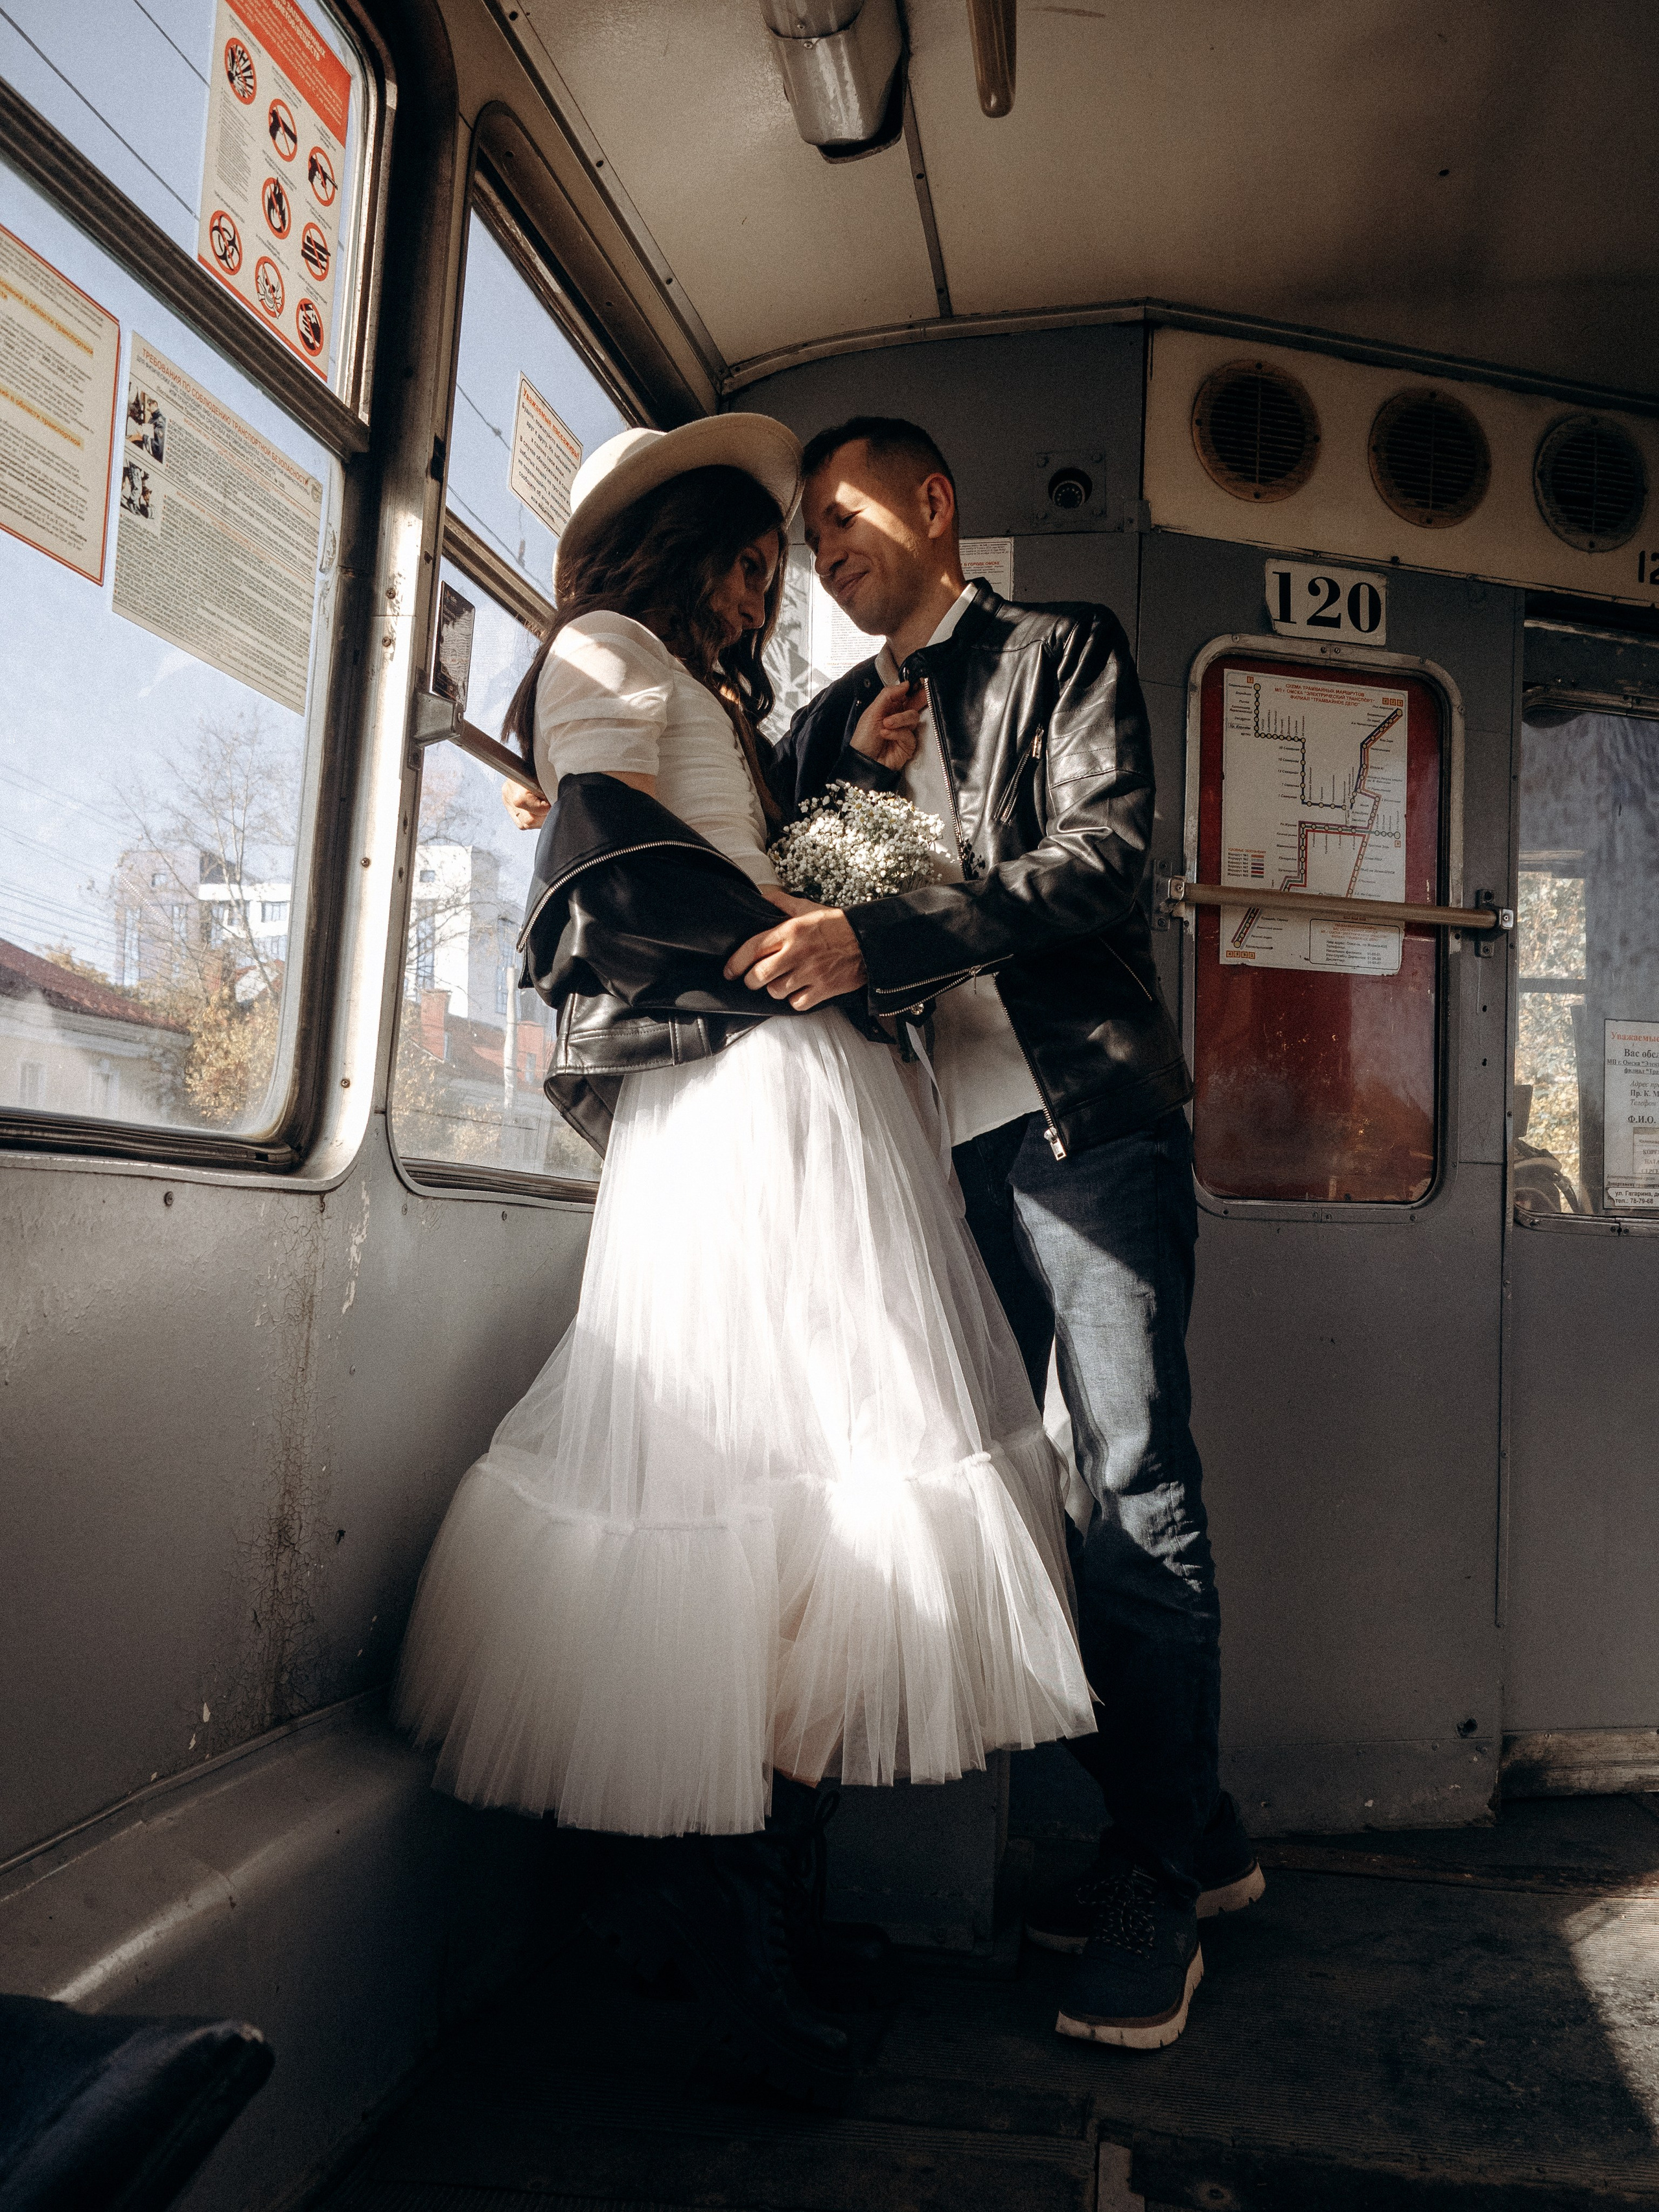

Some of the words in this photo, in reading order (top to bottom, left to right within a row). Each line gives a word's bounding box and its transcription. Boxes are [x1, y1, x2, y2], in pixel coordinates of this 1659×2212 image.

[142, 347, 181, 387] ТРЕБОВАНИЯ
[181, 378, 191, 393] ПО
[191, 387, 231, 426] СОБЛЮДЕНИЮ
[232, 418, 271, 458] ТРАНСПОРТНОЙ
[271, 451, 308, 488] БЕЗОПАСНОСТИ
[523, 386, 552, 428] Уважаемые
[551, 422, 579, 462] пассажиры!
[535, 417, 556, 447] пожалуйста
[518, 457, 523, 467] не
[546, 454, 555, 467] свои
[548, 443, 553, 454] Не
[553, 450, 571, 474] забывайте
[535, 452, 559, 483] обнаружения
[561, 482, 570, 496] салон
[518, 469, 536, 493] сообщите
[549, 502, 567, 526] кондуктор
[1272, 571, 1382, 633] 120
[1303, 685, 1334, 693] ТРАМВАЙНЫХ
[1304, 690, 1345, 700] "ЭЛЕКТРИЧЕСКИЙ
[1346, 695, 1375, 704] ТРАНСПОРТ"
[1311, 696, 1344, 705] "ТРАМВАЙНОЕ
[1611, 1032, 1659, 1042] Уважаемые
[1624, 1047, 1640, 1057] Вас
[1630, 1089, 1642, 1098] Пр.
[1630, 1099, 1656, 1107] Телефон
[1628, 1115, 1656, 1124] Ф.И.О.
